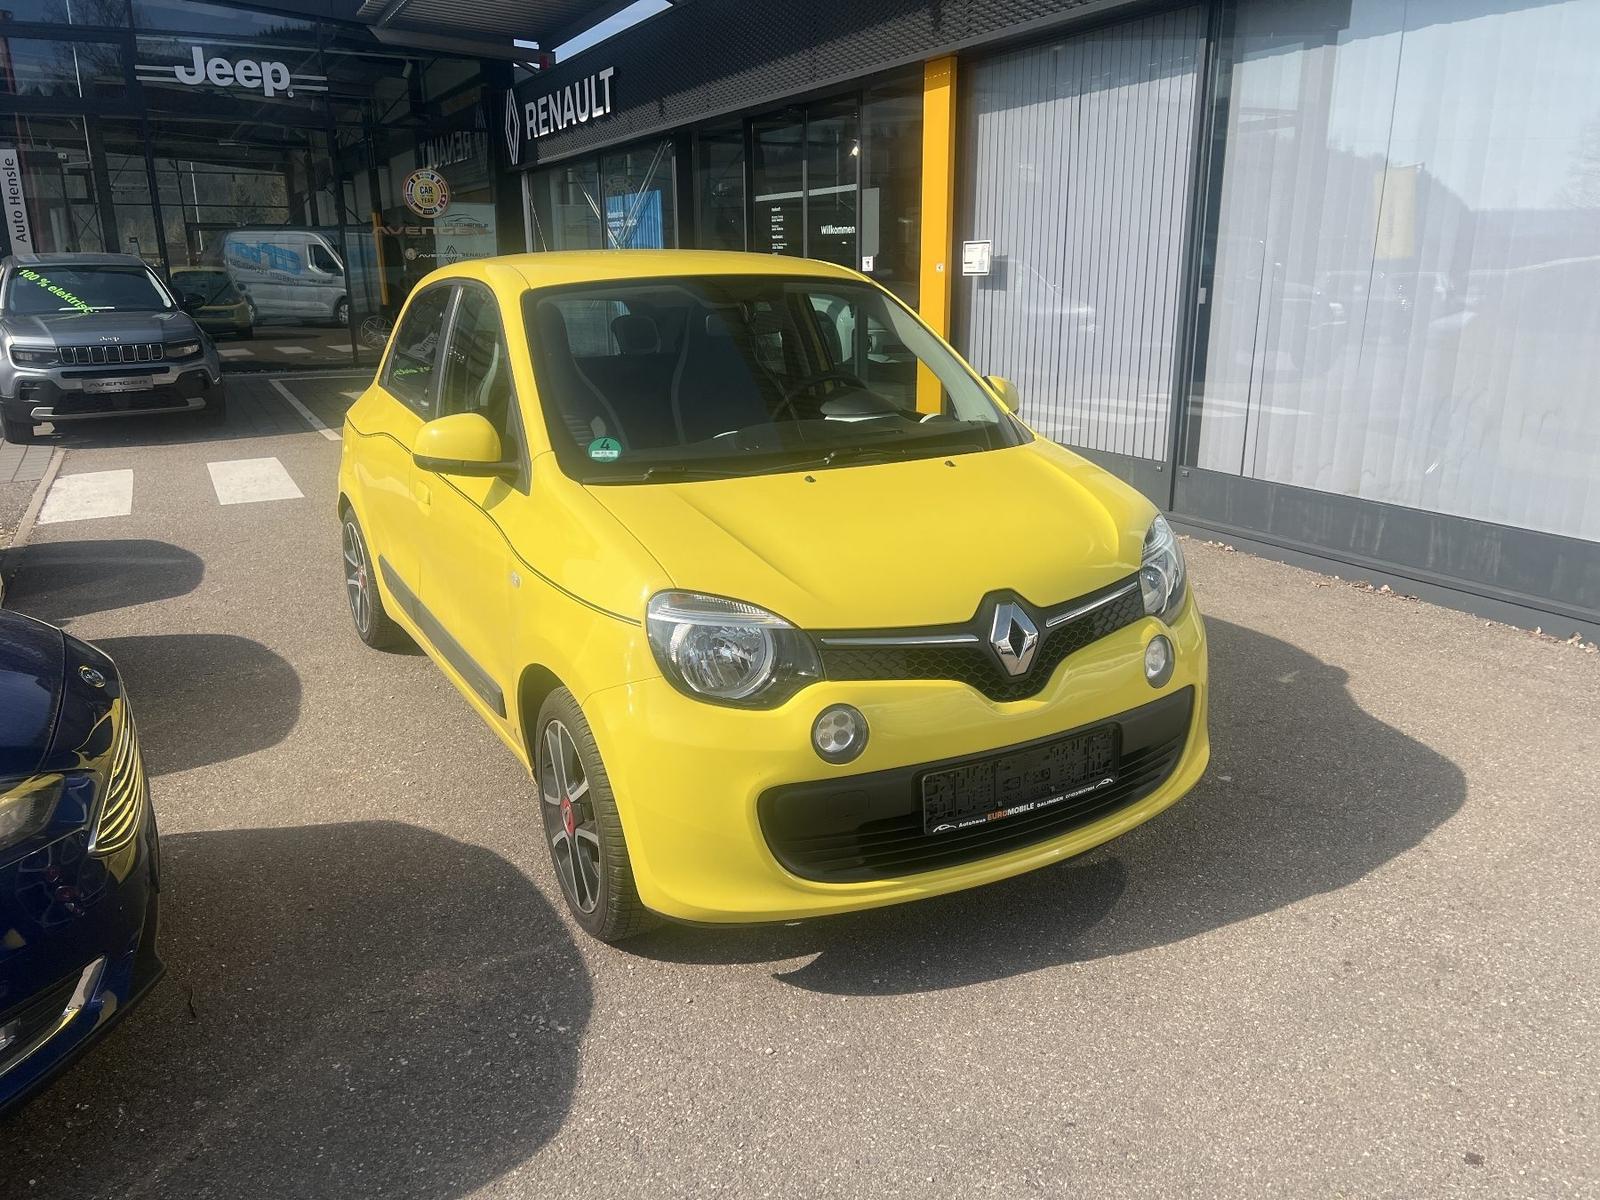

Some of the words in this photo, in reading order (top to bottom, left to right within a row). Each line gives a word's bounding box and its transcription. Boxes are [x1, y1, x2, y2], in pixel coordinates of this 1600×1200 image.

[174, 46, 290, 97] Jeep
[524, 66, 615, 140] RENAULT
[2, 158, 21, 205] Hensle
[420, 186, 433, 195] CAR
[15, 210, 27, 243] Auto
[820, 224, 856, 235] Willkommen
[19, 269, 40, 281] 100
[37, 278, 51, 288] %
[600, 439, 611, 450] 4
[958, 817, 987, 828] Autohaus
[987, 803, 1035, 821] EUROMOBILE
